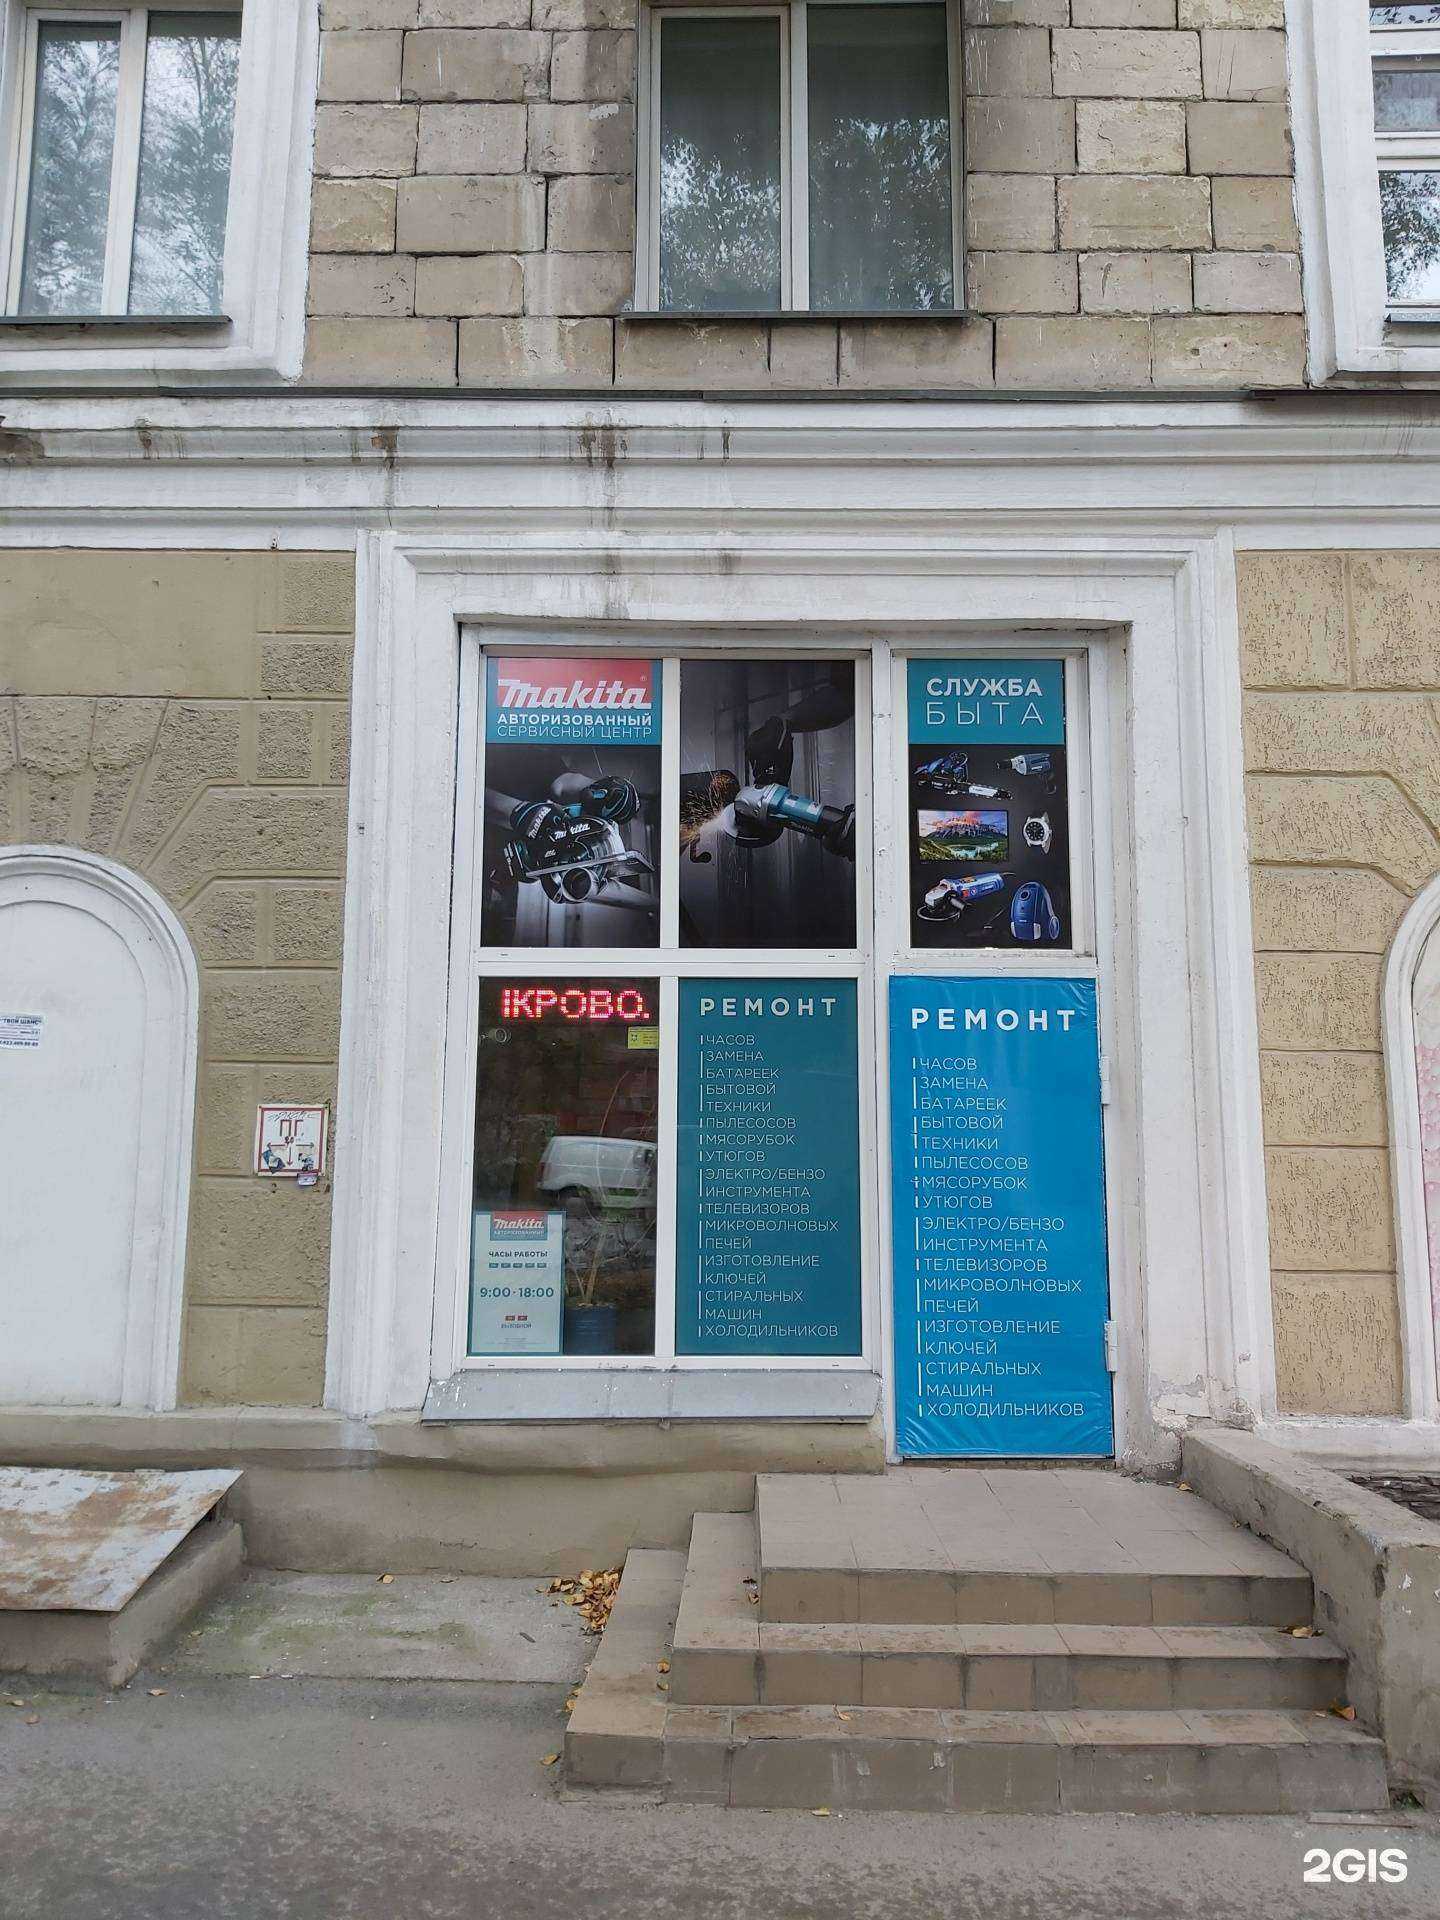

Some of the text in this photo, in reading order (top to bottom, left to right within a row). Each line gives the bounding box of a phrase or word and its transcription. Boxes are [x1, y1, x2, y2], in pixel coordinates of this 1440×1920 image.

[926, 678, 1043, 697] СЛУЖБА
[497, 713, 652, 726] АВТОРИЗОВАННЫЙ
[926, 702, 1044, 725] БЫТА
[497, 725, 652, 739] СЕРВИСНЫЙ ЦЕНТР
[700, 998, 836, 1016] РЕМОНТ
[912, 1008, 1075, 1031] РЕМОНТ
[706, 1035, 755, 1045] ЧАСОВ
[706, 1051, 764, 1061] ЗАМЕНА
[920, 1058, 977, 1070] ЧАСОВ
[706, 1068, 779, 1078] БАТАРЕЕК
[706, 1083, 776, 1095] БЫТОВОЙ
[920, 1077, 988, 1089] ЗАМЕНА
[706, 1102, 771, 1112] ТЕХНИКИ
[921, 1098, 1007, 1110] БАТАРЕЕК
[706, 1118, 796, 1128] ПЫЛЕСОСОВ
[921, 1115, 1003, 1128] БЫТОВОЙ
[706, 1135, 795, 1145] МЯСОРУБОК
[922, 1137, 998, 1150] ТЕХНИКИ
[706, 1151, 765, 1161] УТЮГОВ
[922, 1156, 1028, 1169] ПЫЛЕСОСОВ
[705, 1169, 825, 1180] ЭЛЕКТРО/БЕНЗО
[922, 1177, 1027, 1189] МЯСОРУБОК
[706, 1186, 810, 1198] ИНСТРУМЕНТА
[706, 1203, 810, 1214] ТЕЛЕВИЗОРОВ
[923, 1196, 992, 1209] УТЮГОВ
[706, 1221, 839, 1231] МИКРОВОЛНОВЫХ
[923, 1217, 1064, 1230] ЭЛЕКТРО/БЕНЗО
[706, 1236, 751, 1249] ПЕЧЕЙ
[923, 1239, 1048, 1251] ИНСТРУМЕНТА
[706, 1255, 820, 1267] ИЗГОТОВЛЕНИЕ
[924, 1259, 1047, 1271] ТЕЛЕВИЗОРОВ
[706, 1272, 766, 1284] КЛЮЧЕЙ
[924, 1279, 1082, 1292] МИКРОВОЛНОВЫХ
[706, 1290, 803, 1301] СТИРАЛЬНЫХ
[924, 1298, 979, 1312] ПЕЧЕЙ
[706, 1308, 762, 1319] МАШИН
[706, 1325, 838, 1338] ХОЛОДИЛЬНИКОВ
[925, 1320, 1060, 1333] ИЗГОТОВЛЕНИЕ
[926, 1339, 997, 1355] КЛЮЧЕЙ
[926, 1362, 1041, 1375] СТИРАЛЬНЫХ
[926, 1384, 993, 1396] МАШИН
[927, 1403, 1084, 1417] ХОЛОДИЛЬНИКОВ
